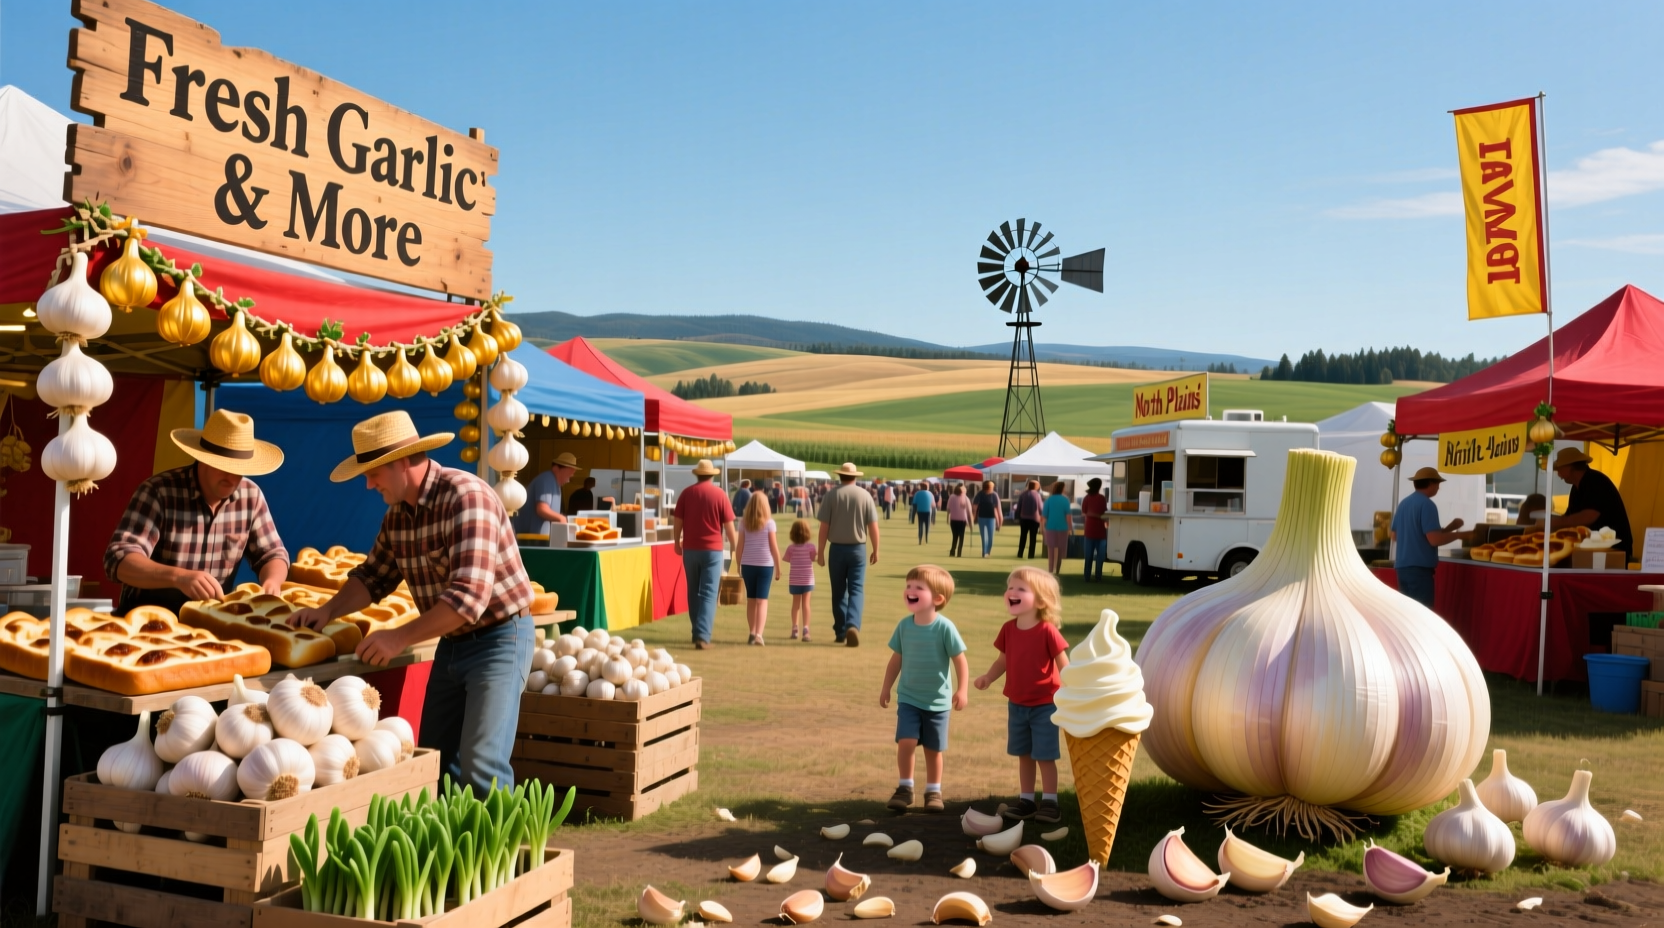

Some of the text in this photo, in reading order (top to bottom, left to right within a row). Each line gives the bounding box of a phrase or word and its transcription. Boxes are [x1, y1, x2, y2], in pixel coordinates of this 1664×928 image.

[119, 17, 478, 211] Fresh Garlic
[214, 153, 423, 267] & More
